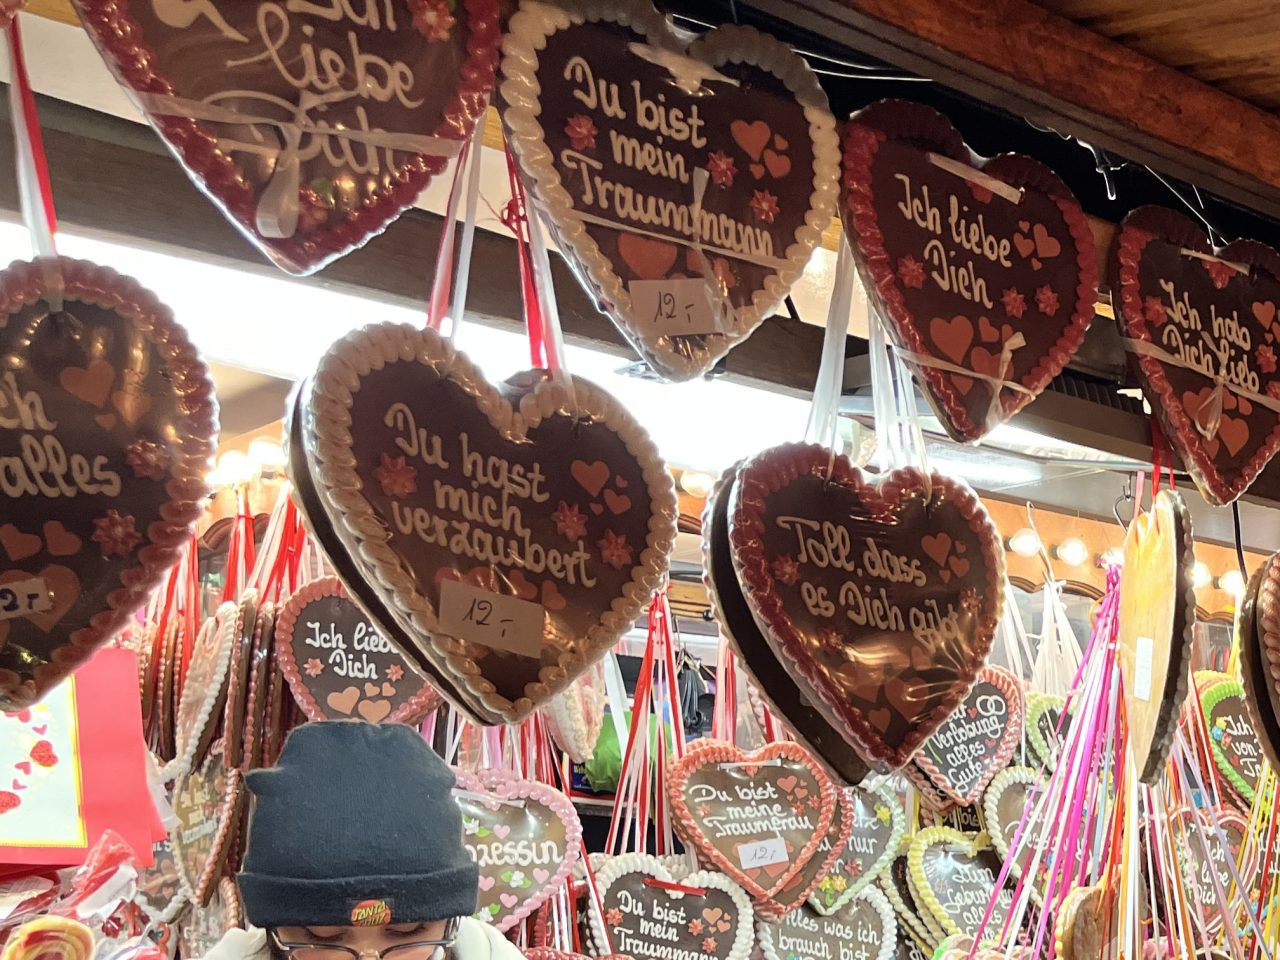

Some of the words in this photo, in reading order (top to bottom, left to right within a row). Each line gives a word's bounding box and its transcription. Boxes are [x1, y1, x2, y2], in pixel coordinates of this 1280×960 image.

[564, 56, 626, 120] Du
[632, 80, 707, 149] bist
[610, 128, 689, 184] mein
[561, 149, 774, 256] Traummann
[893, 173, 942, 234] Ich
[948, 195, 1013, 267] liebe
[923, 241, 994, 309] Dich
[1158, 278, 1202, 331] Ich
[1210, 305, 1252, 351] hab
[1161, 323, 1215, 377] Dich
[1220, 347, 1261, 392] lieb
[0, 434, 121, 498] alles
[384, 403, 449, 468] Du
[462, 433, 550, 502] hast
[434, 481, 530, 538] mich
[392, 502, 597, 588] verzaubert
[863, 538, 927, 586] dass
[801, 581, 836, 618] es
[839, 580, 905, 632] Dich
[306, 622, 347, 650] Ich
[328, 650, 379, 680] Dich
[930, 715, 1004, 750] Verlobung
[946, 740, 985, 767] alles
[689, 784, 733, 803] Du
[735, 782, 778, 800] bist
[948, 760, 984, 793] Gute
[703, 814, 814, 842] Traumfrau
[726, 801, 787, 820] meine
[848, 836, 877, 855] nur
[616, 890, 646, 917] Du
[652, 899, 687, 925] bist
[640, 917, 680, 942] mein
[824, 919, 854, 939] was
[857, 920, 882, 946] ich
